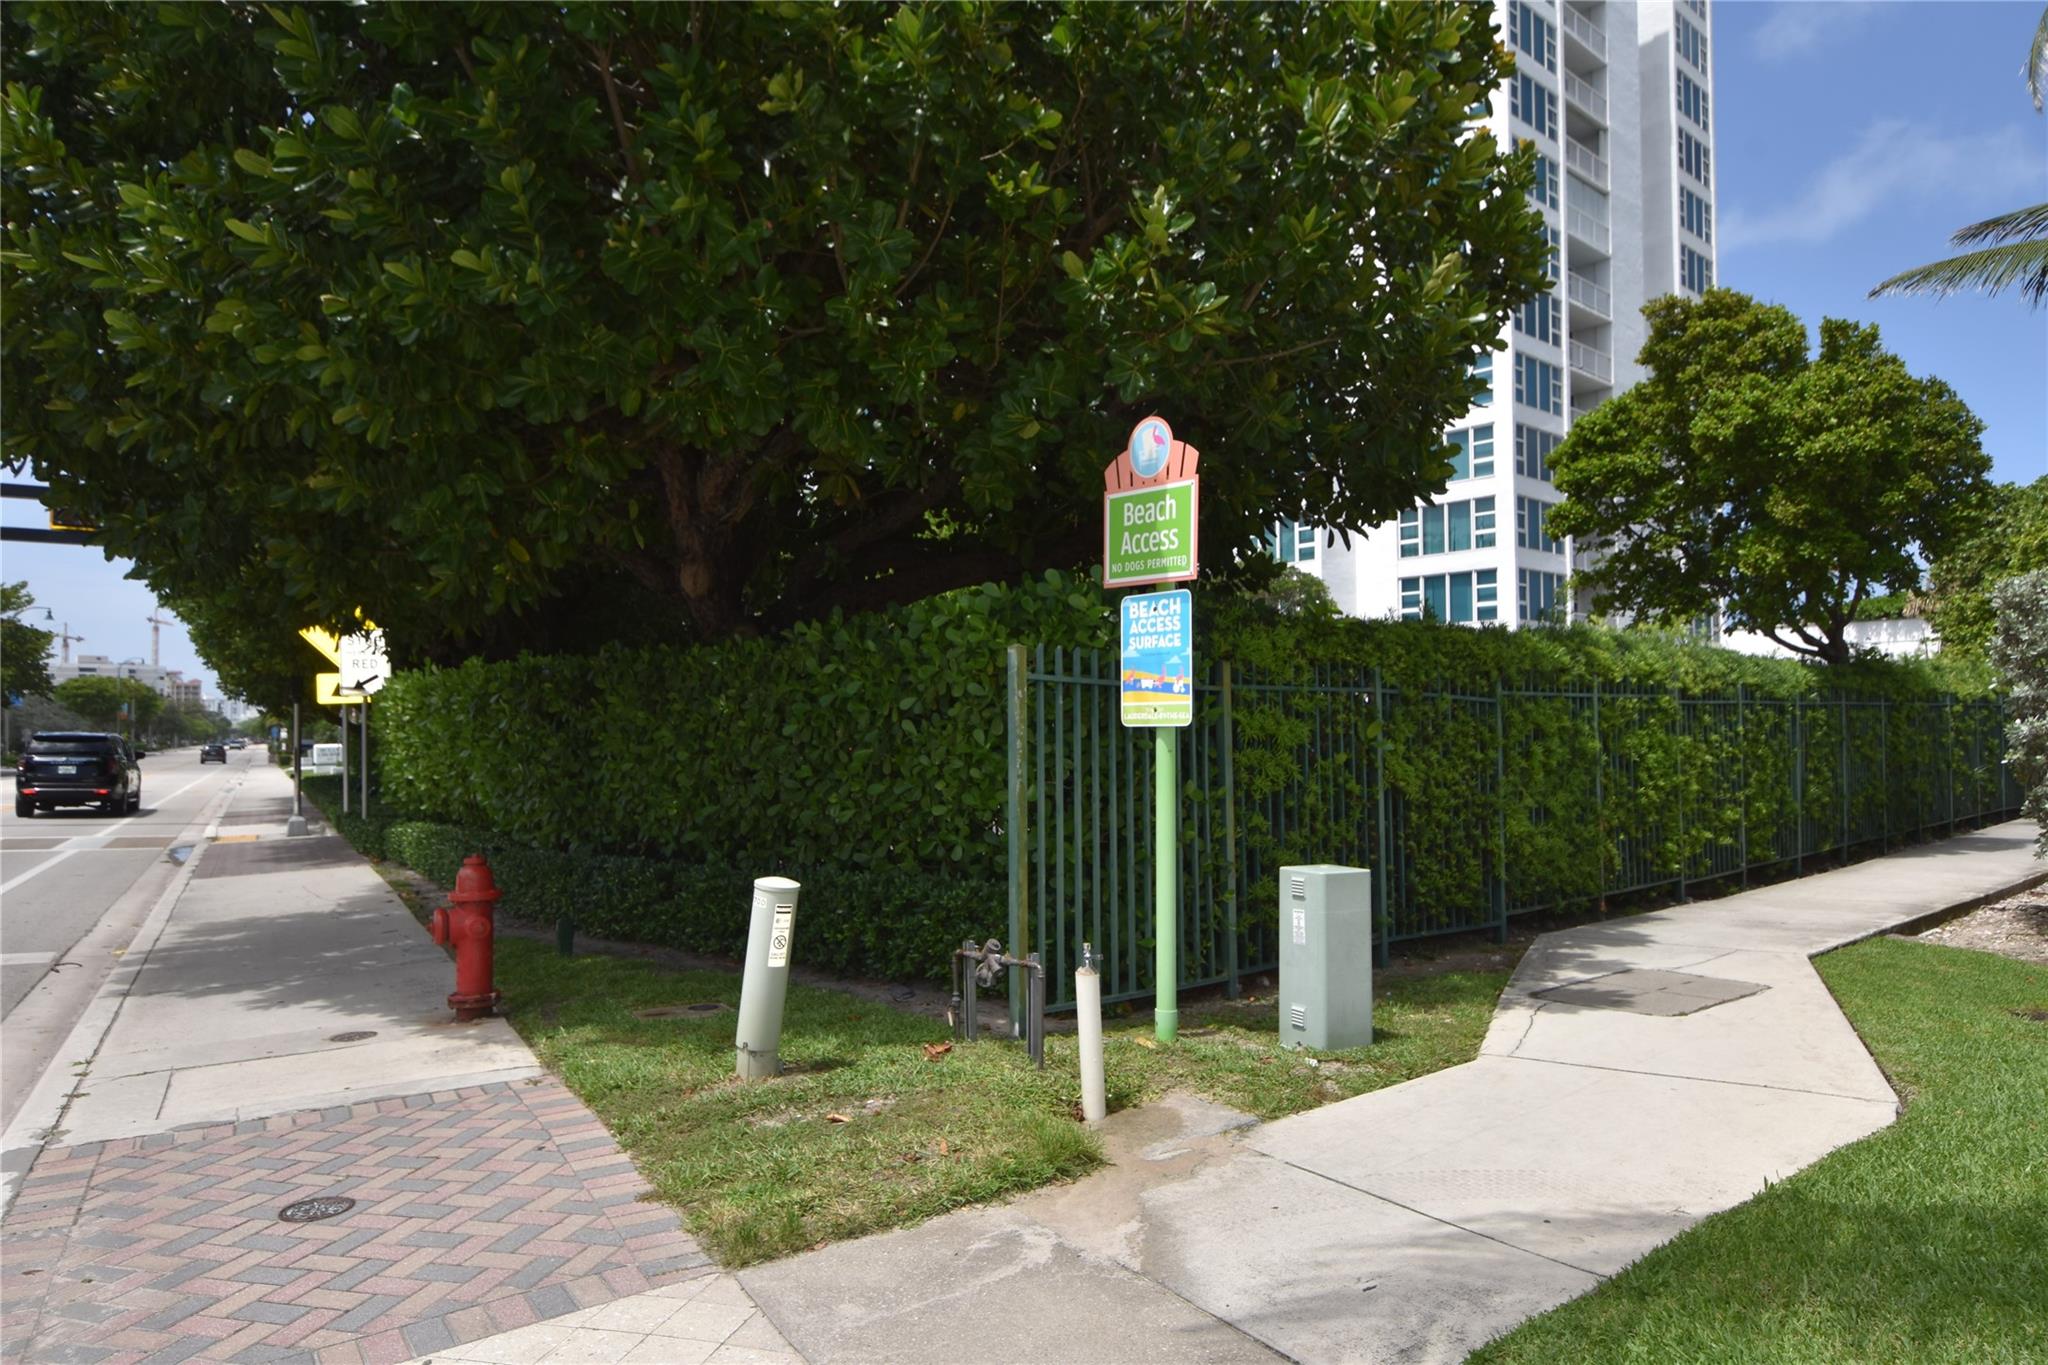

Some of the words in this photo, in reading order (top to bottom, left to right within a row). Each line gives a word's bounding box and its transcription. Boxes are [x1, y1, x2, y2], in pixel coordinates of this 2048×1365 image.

[1123, 493, 1177, 526] Beach
[1120, 528, 1179, 556] Access
[1111, 563, 1122, 573] NO
[1124, 559, 1145, 572] DOGS
[1147, 554, 1187, 569] PERMITTED
[1129, 597, 1181, 619] BEACH
[1129, 615, 1181, 634] ACCESS
[1128, 632, 1182, 650] SURFACE
[352, 658, 378, 669] RED
